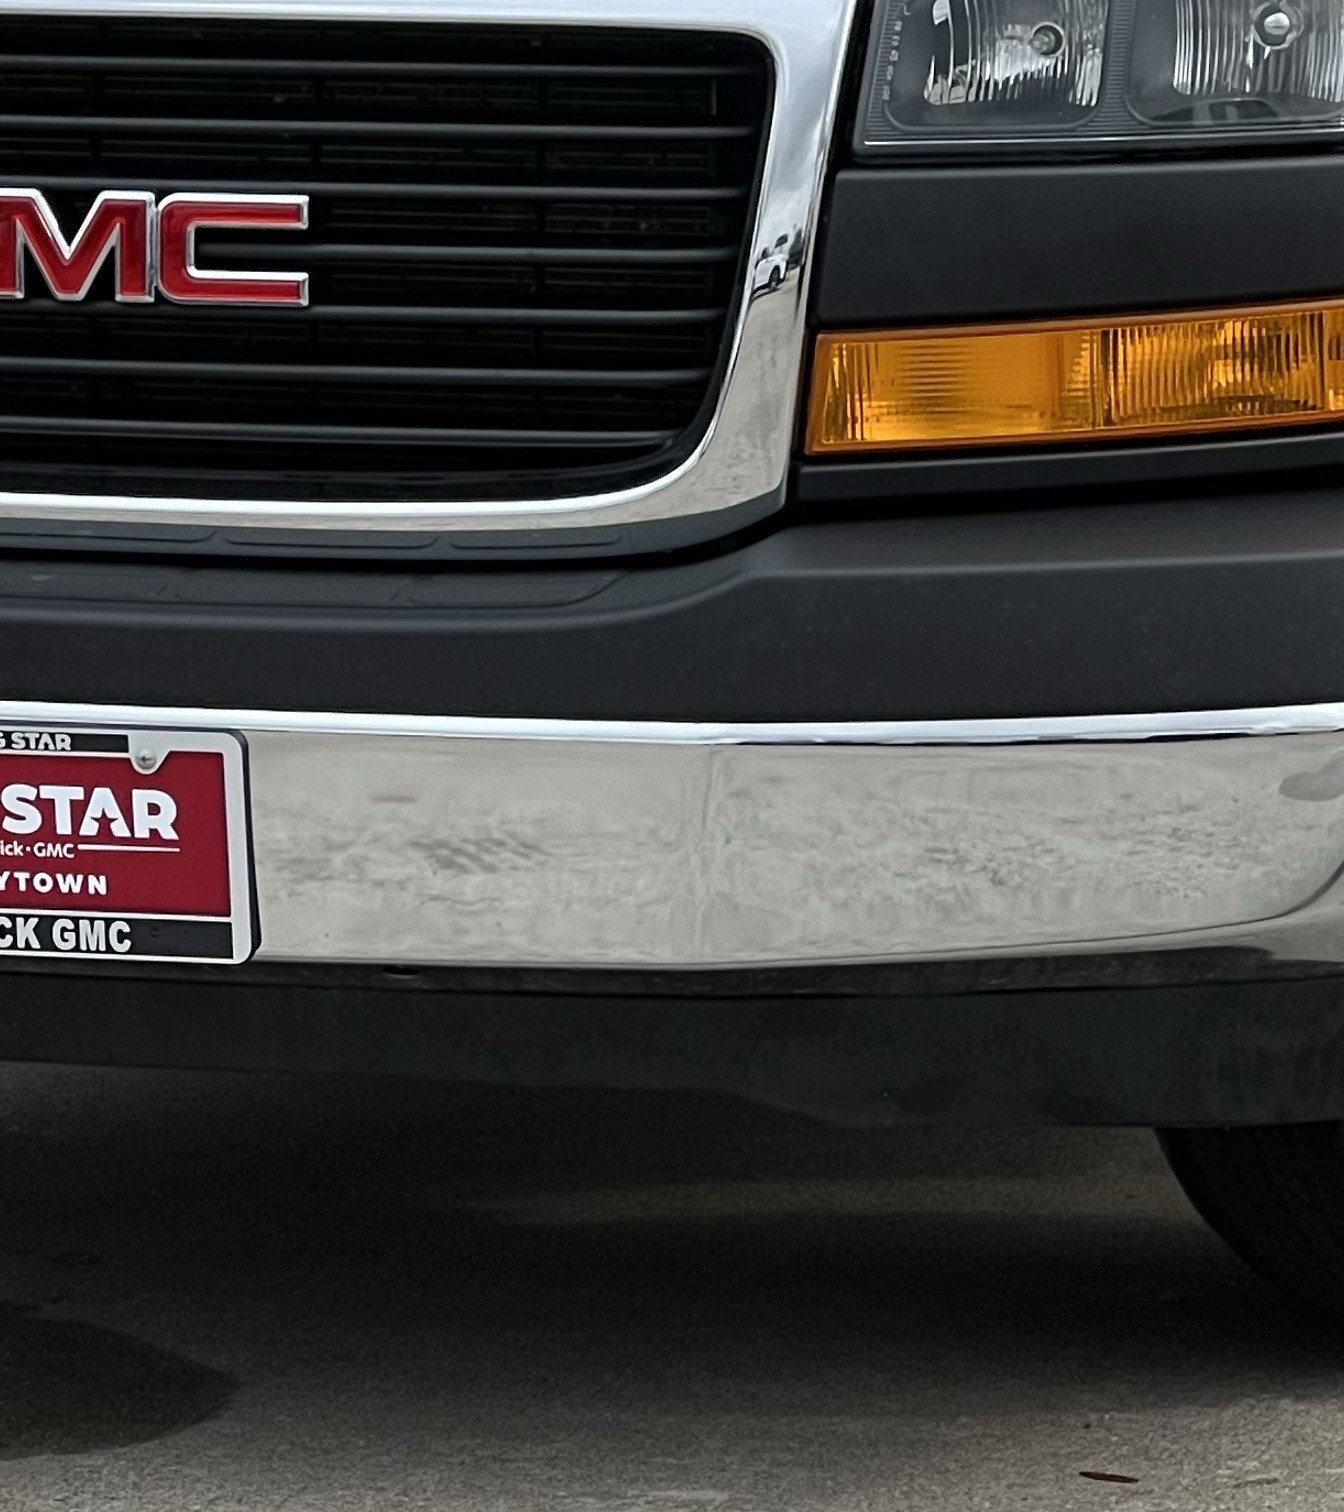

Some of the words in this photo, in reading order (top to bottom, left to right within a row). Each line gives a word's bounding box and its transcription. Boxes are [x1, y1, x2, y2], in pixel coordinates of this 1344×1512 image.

[10, 732, 72, 751] STAR
[0, 783, 179, 840] STAR
[33, 841, 75, 859] GMC
[52, 919, 132, 953] GMC
